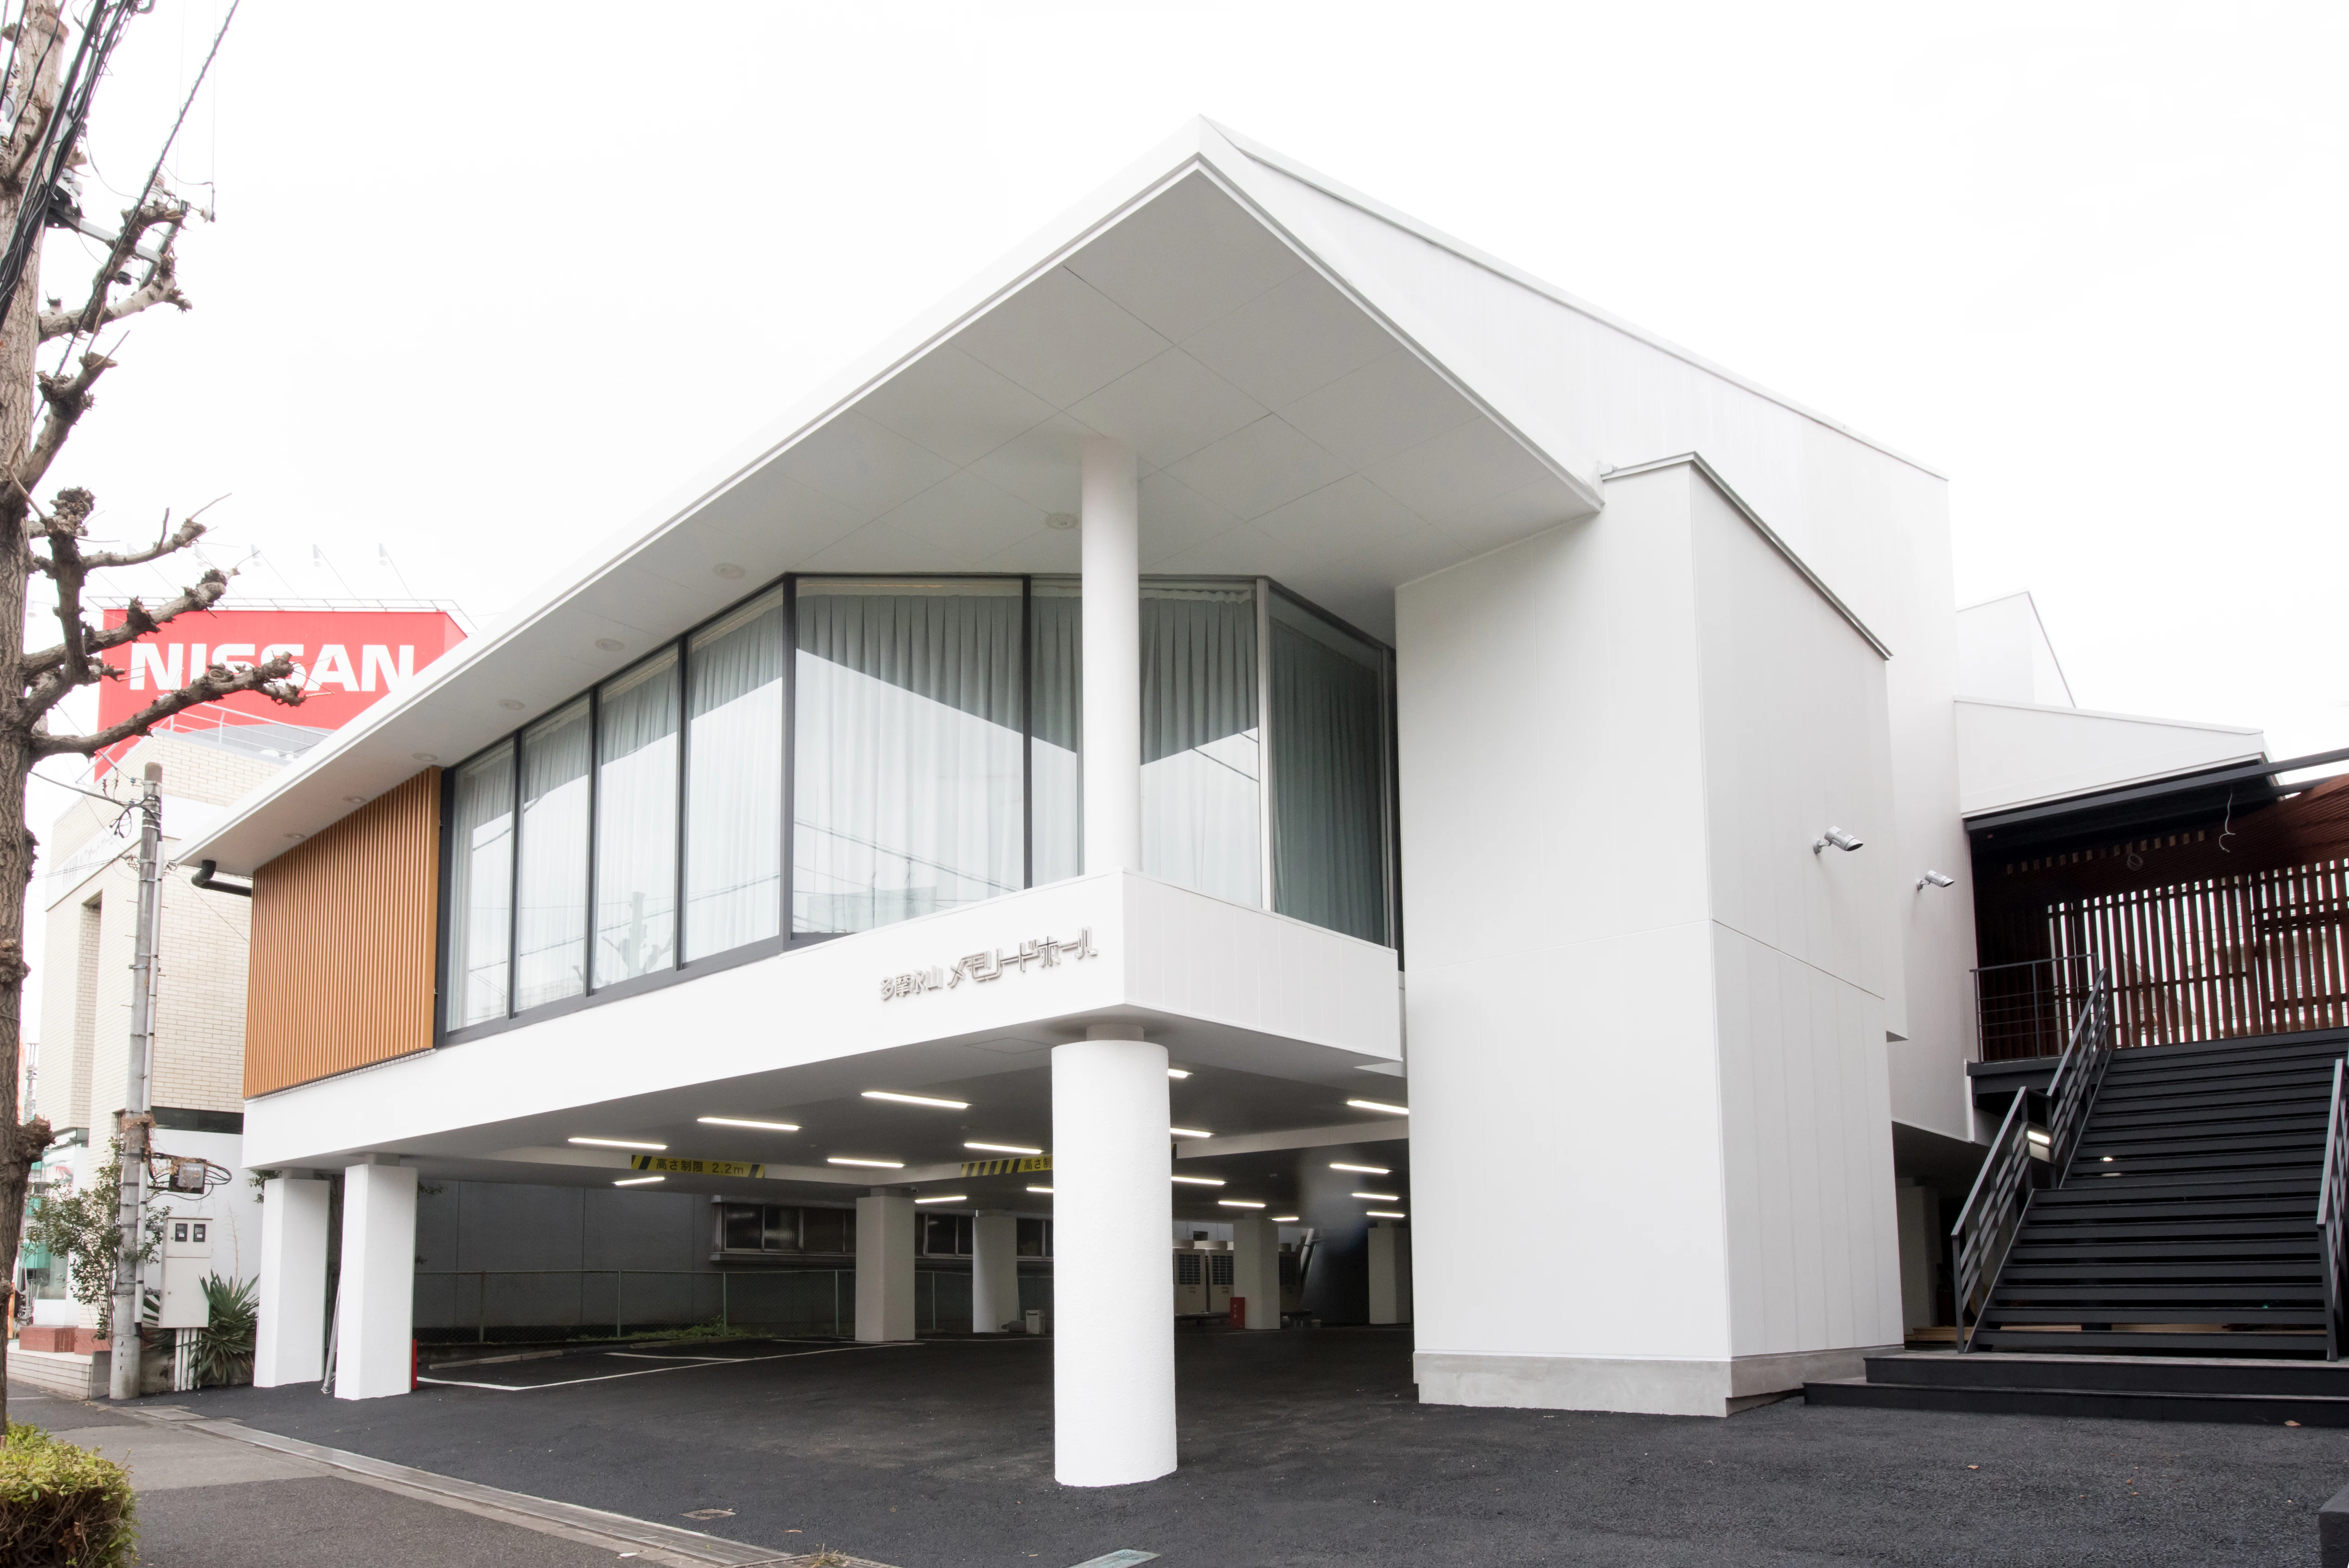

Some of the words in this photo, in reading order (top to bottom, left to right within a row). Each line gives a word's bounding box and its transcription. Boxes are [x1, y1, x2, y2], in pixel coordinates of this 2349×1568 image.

[879, 965, 943, 1001] 多摩永山
[947, 926, 1098, 989] メモリードホール
[656, 1158, 703, 1172] 高さ制限
[712, 1163, 743, 1174] 2.2m
